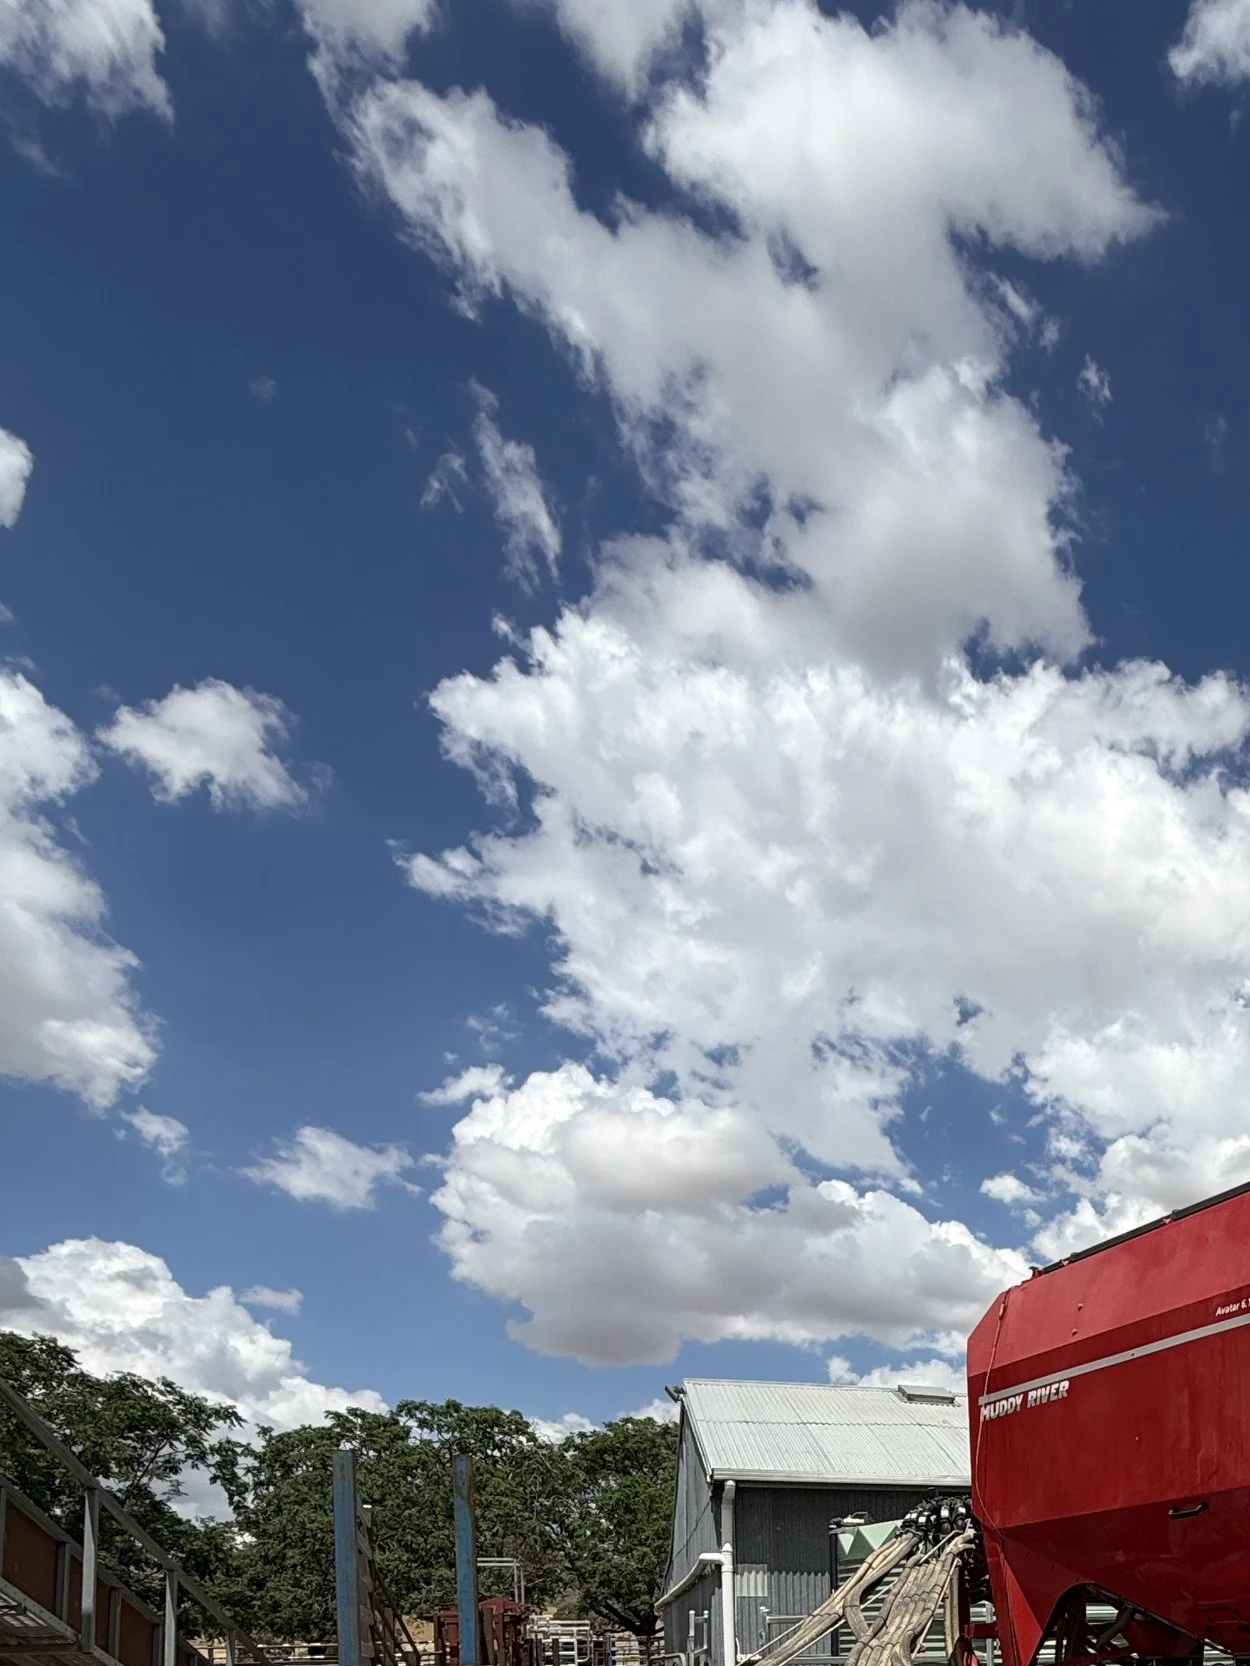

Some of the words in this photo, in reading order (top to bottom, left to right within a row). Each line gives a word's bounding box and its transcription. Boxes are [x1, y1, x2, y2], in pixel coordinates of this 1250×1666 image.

[1215, 1302, 1240, 1317] Avatar
[980, 1394, 1024, 1422] MUDDY
[1027, 1380, 1070, 1409] RIVER
